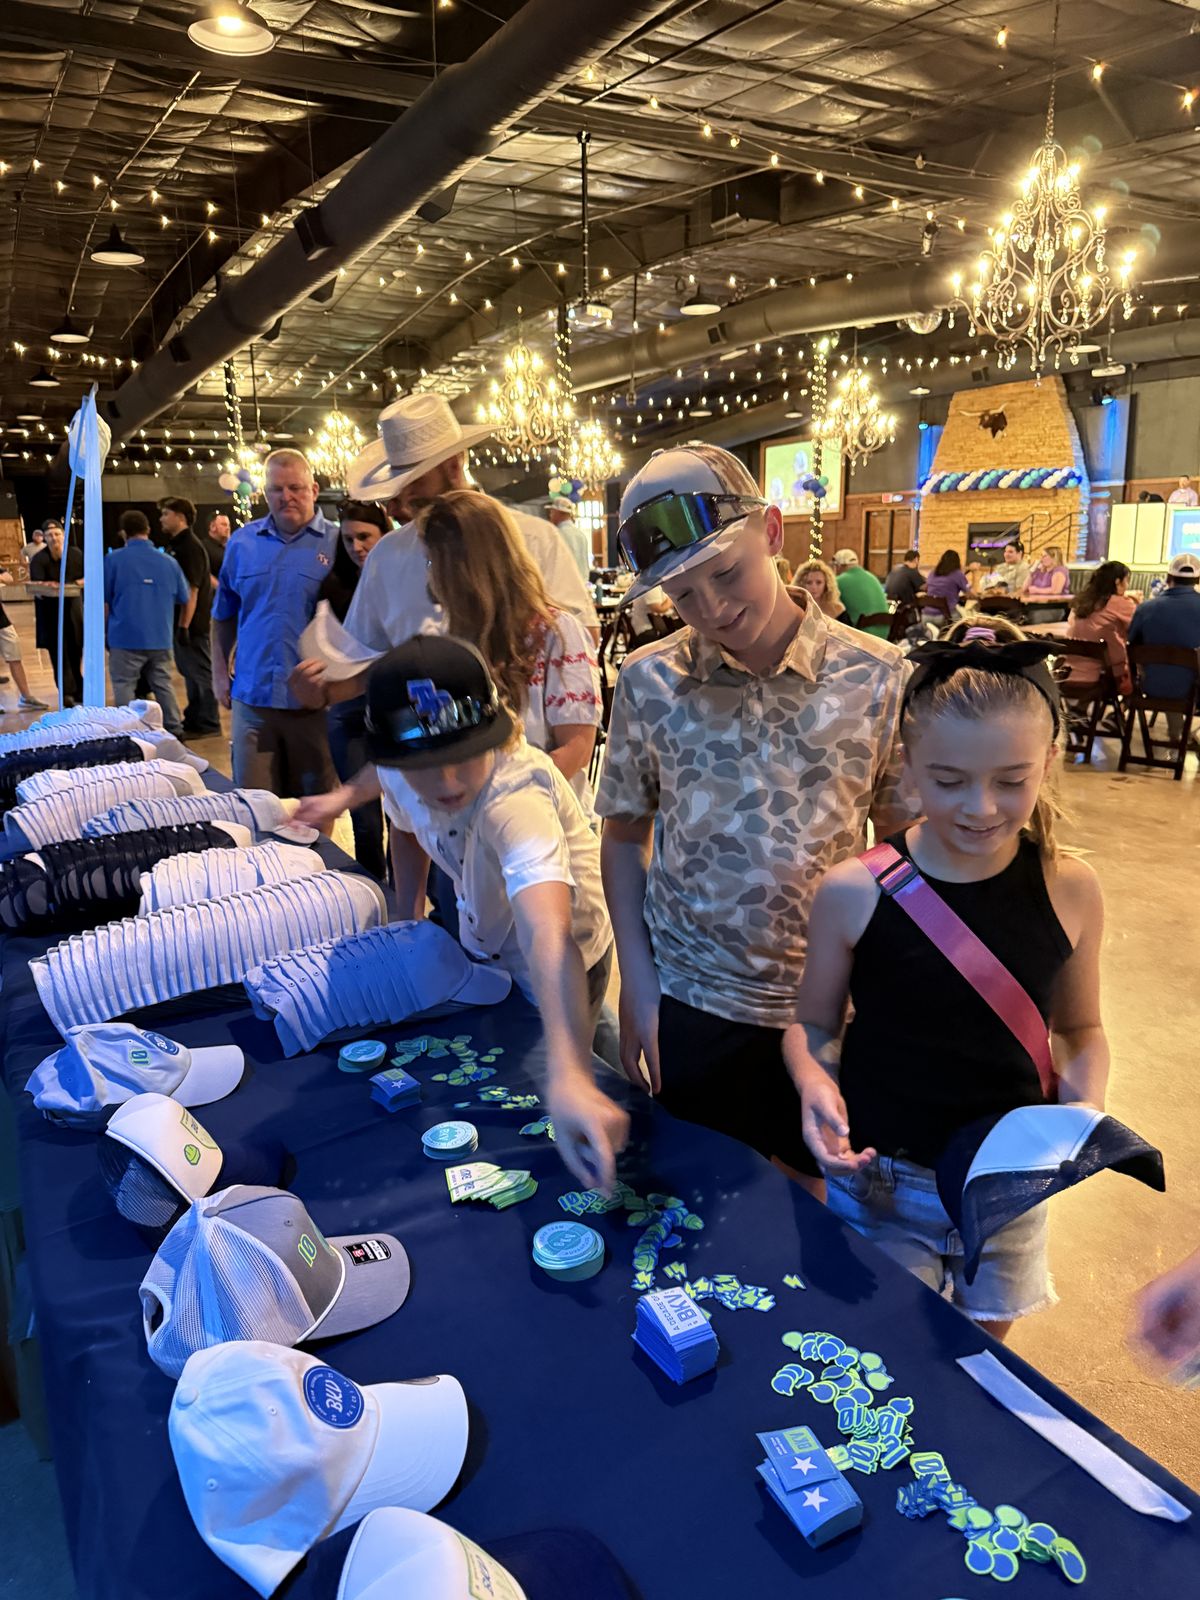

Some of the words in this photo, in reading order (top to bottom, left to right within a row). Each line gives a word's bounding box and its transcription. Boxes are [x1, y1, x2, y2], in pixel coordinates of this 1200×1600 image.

[298, 1233, 317, 1268] 10
[663, 1294, 697, 1321] BKV
[325, 1379, 343, 1413] BKV
[838, 1407, 864, 1432] 10
